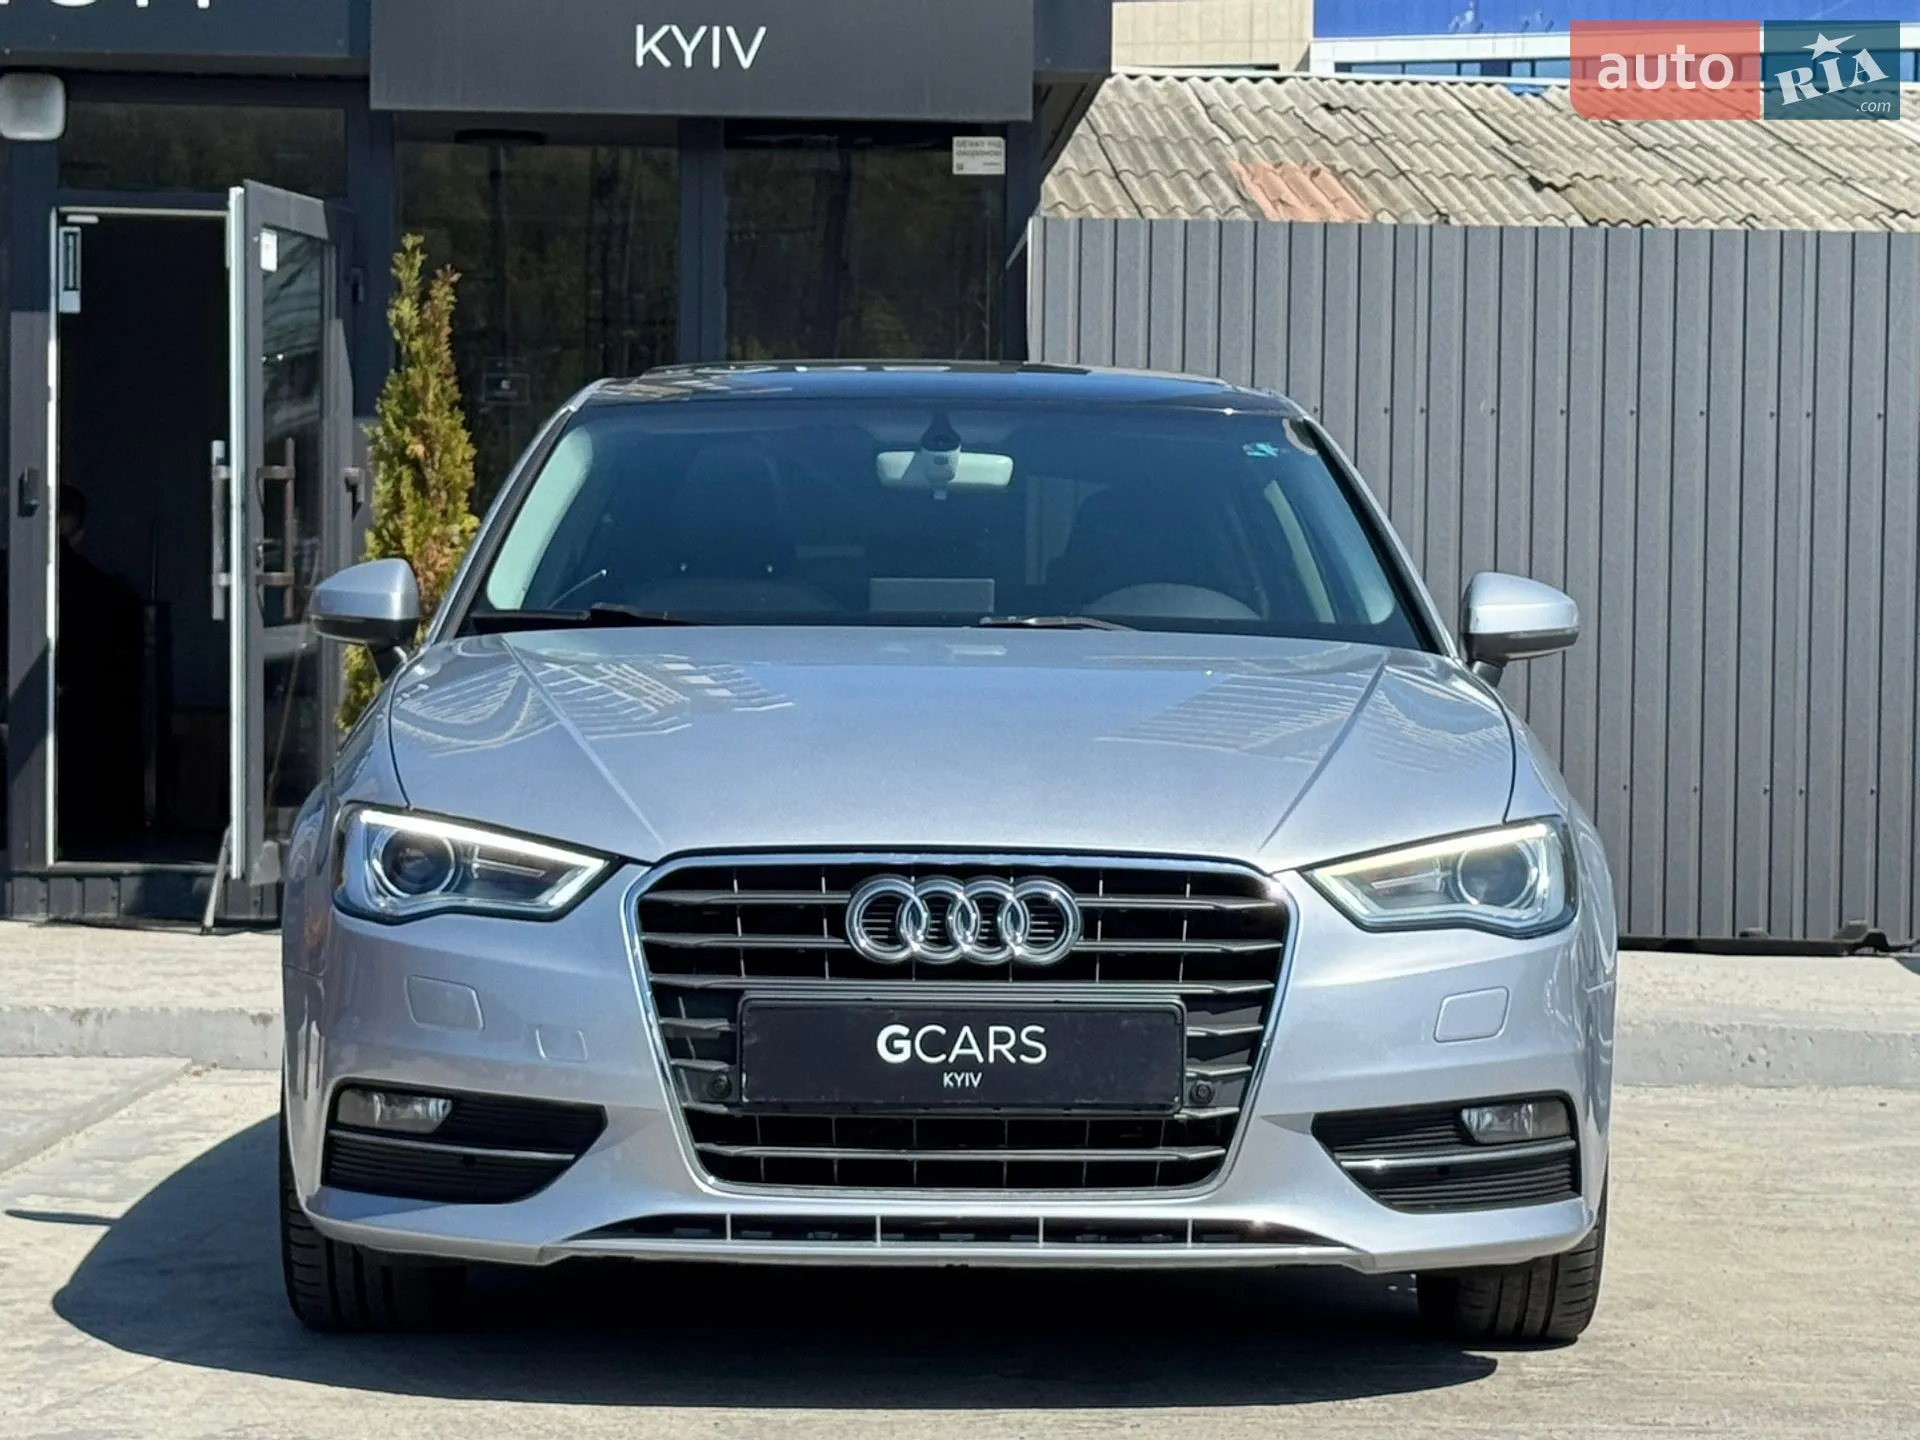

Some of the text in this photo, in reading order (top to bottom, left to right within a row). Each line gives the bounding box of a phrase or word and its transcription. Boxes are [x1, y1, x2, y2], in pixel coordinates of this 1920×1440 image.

[635, 24, 767, 69] KYIV
[876, 1024, 1047, 1064] GCARS
[943, 1072, 983, 1088] KYIV
